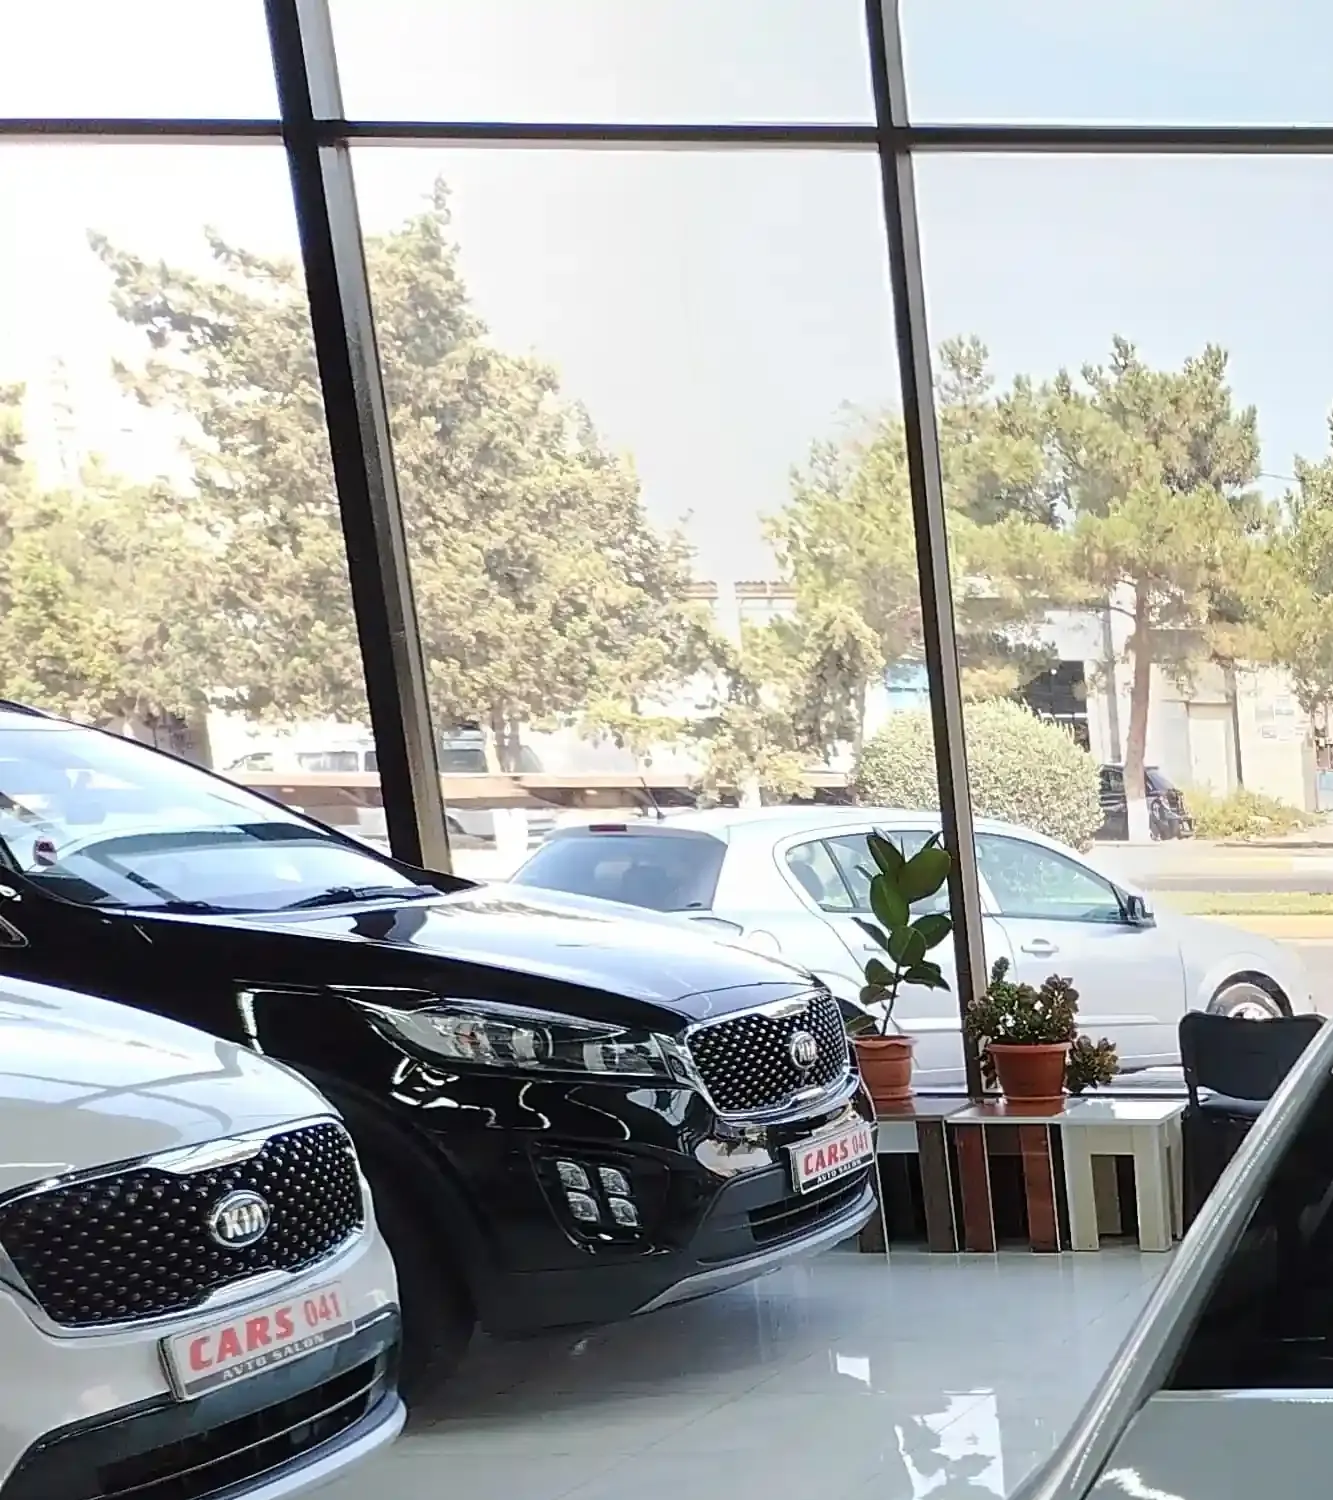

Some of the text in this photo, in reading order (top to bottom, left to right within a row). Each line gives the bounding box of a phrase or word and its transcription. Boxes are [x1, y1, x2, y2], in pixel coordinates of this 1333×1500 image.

[803, 1130, 869, 1177] CARS 041
[221, 1204, 266, 1239] KIA
[190, 1290, 342, 1371] CARS 041
[222, 1334, 325, 1382] AVTO SALON
